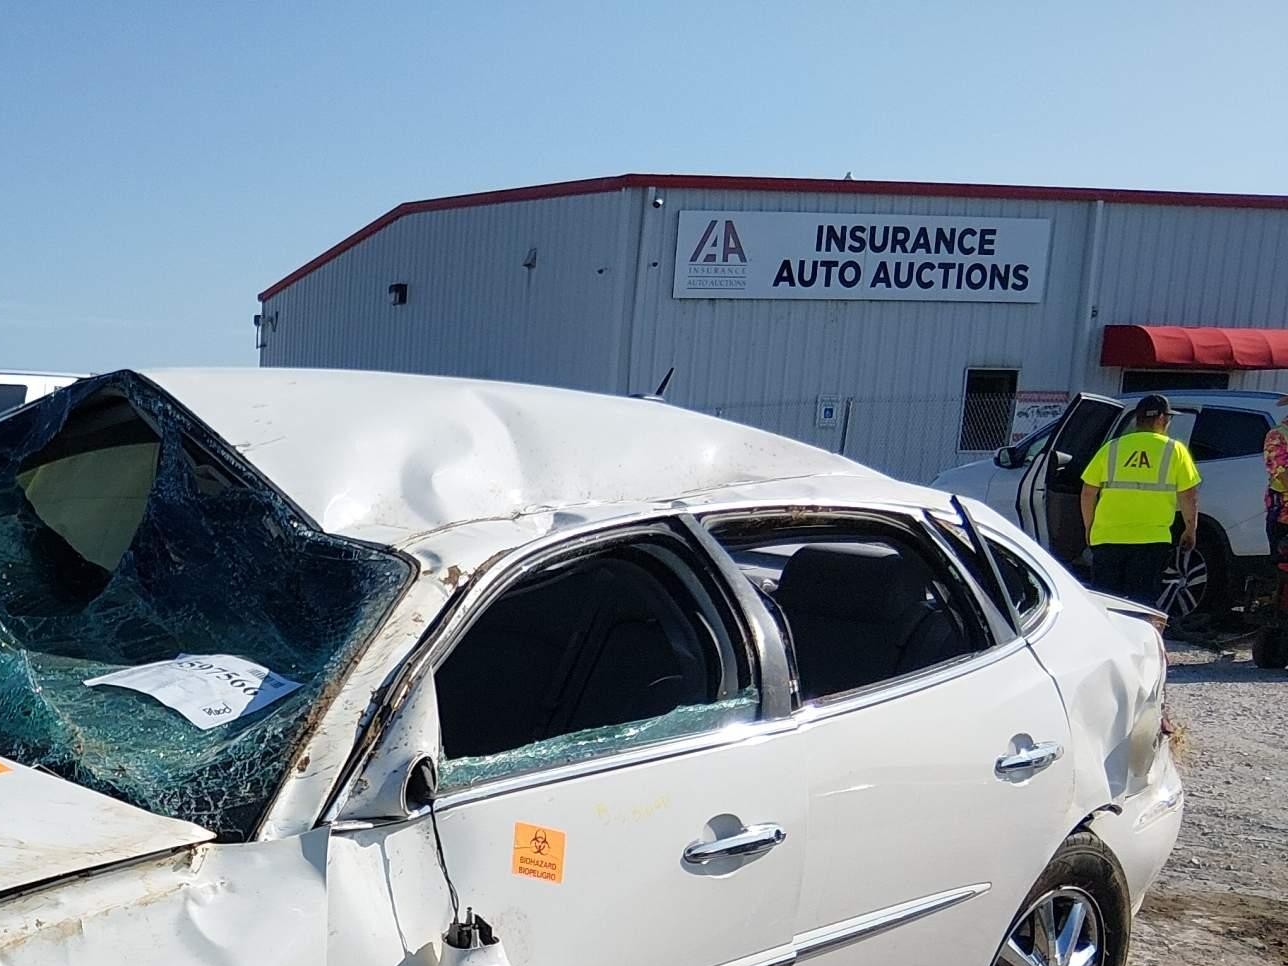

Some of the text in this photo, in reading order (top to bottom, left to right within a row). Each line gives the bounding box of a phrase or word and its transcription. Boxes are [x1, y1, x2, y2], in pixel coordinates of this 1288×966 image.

[814, 224, 997, 256] INSURANCE
[687, 279, 746, 287] AUTO AUCTIONS
[772, 259, 1030, 291] AUTO AUCTIONS
[178, 660, 263, 696] 597566
[518, 866, 556, 880] BIOPELIGRO
[520, 856, 557, 870] BIOHAZARD
